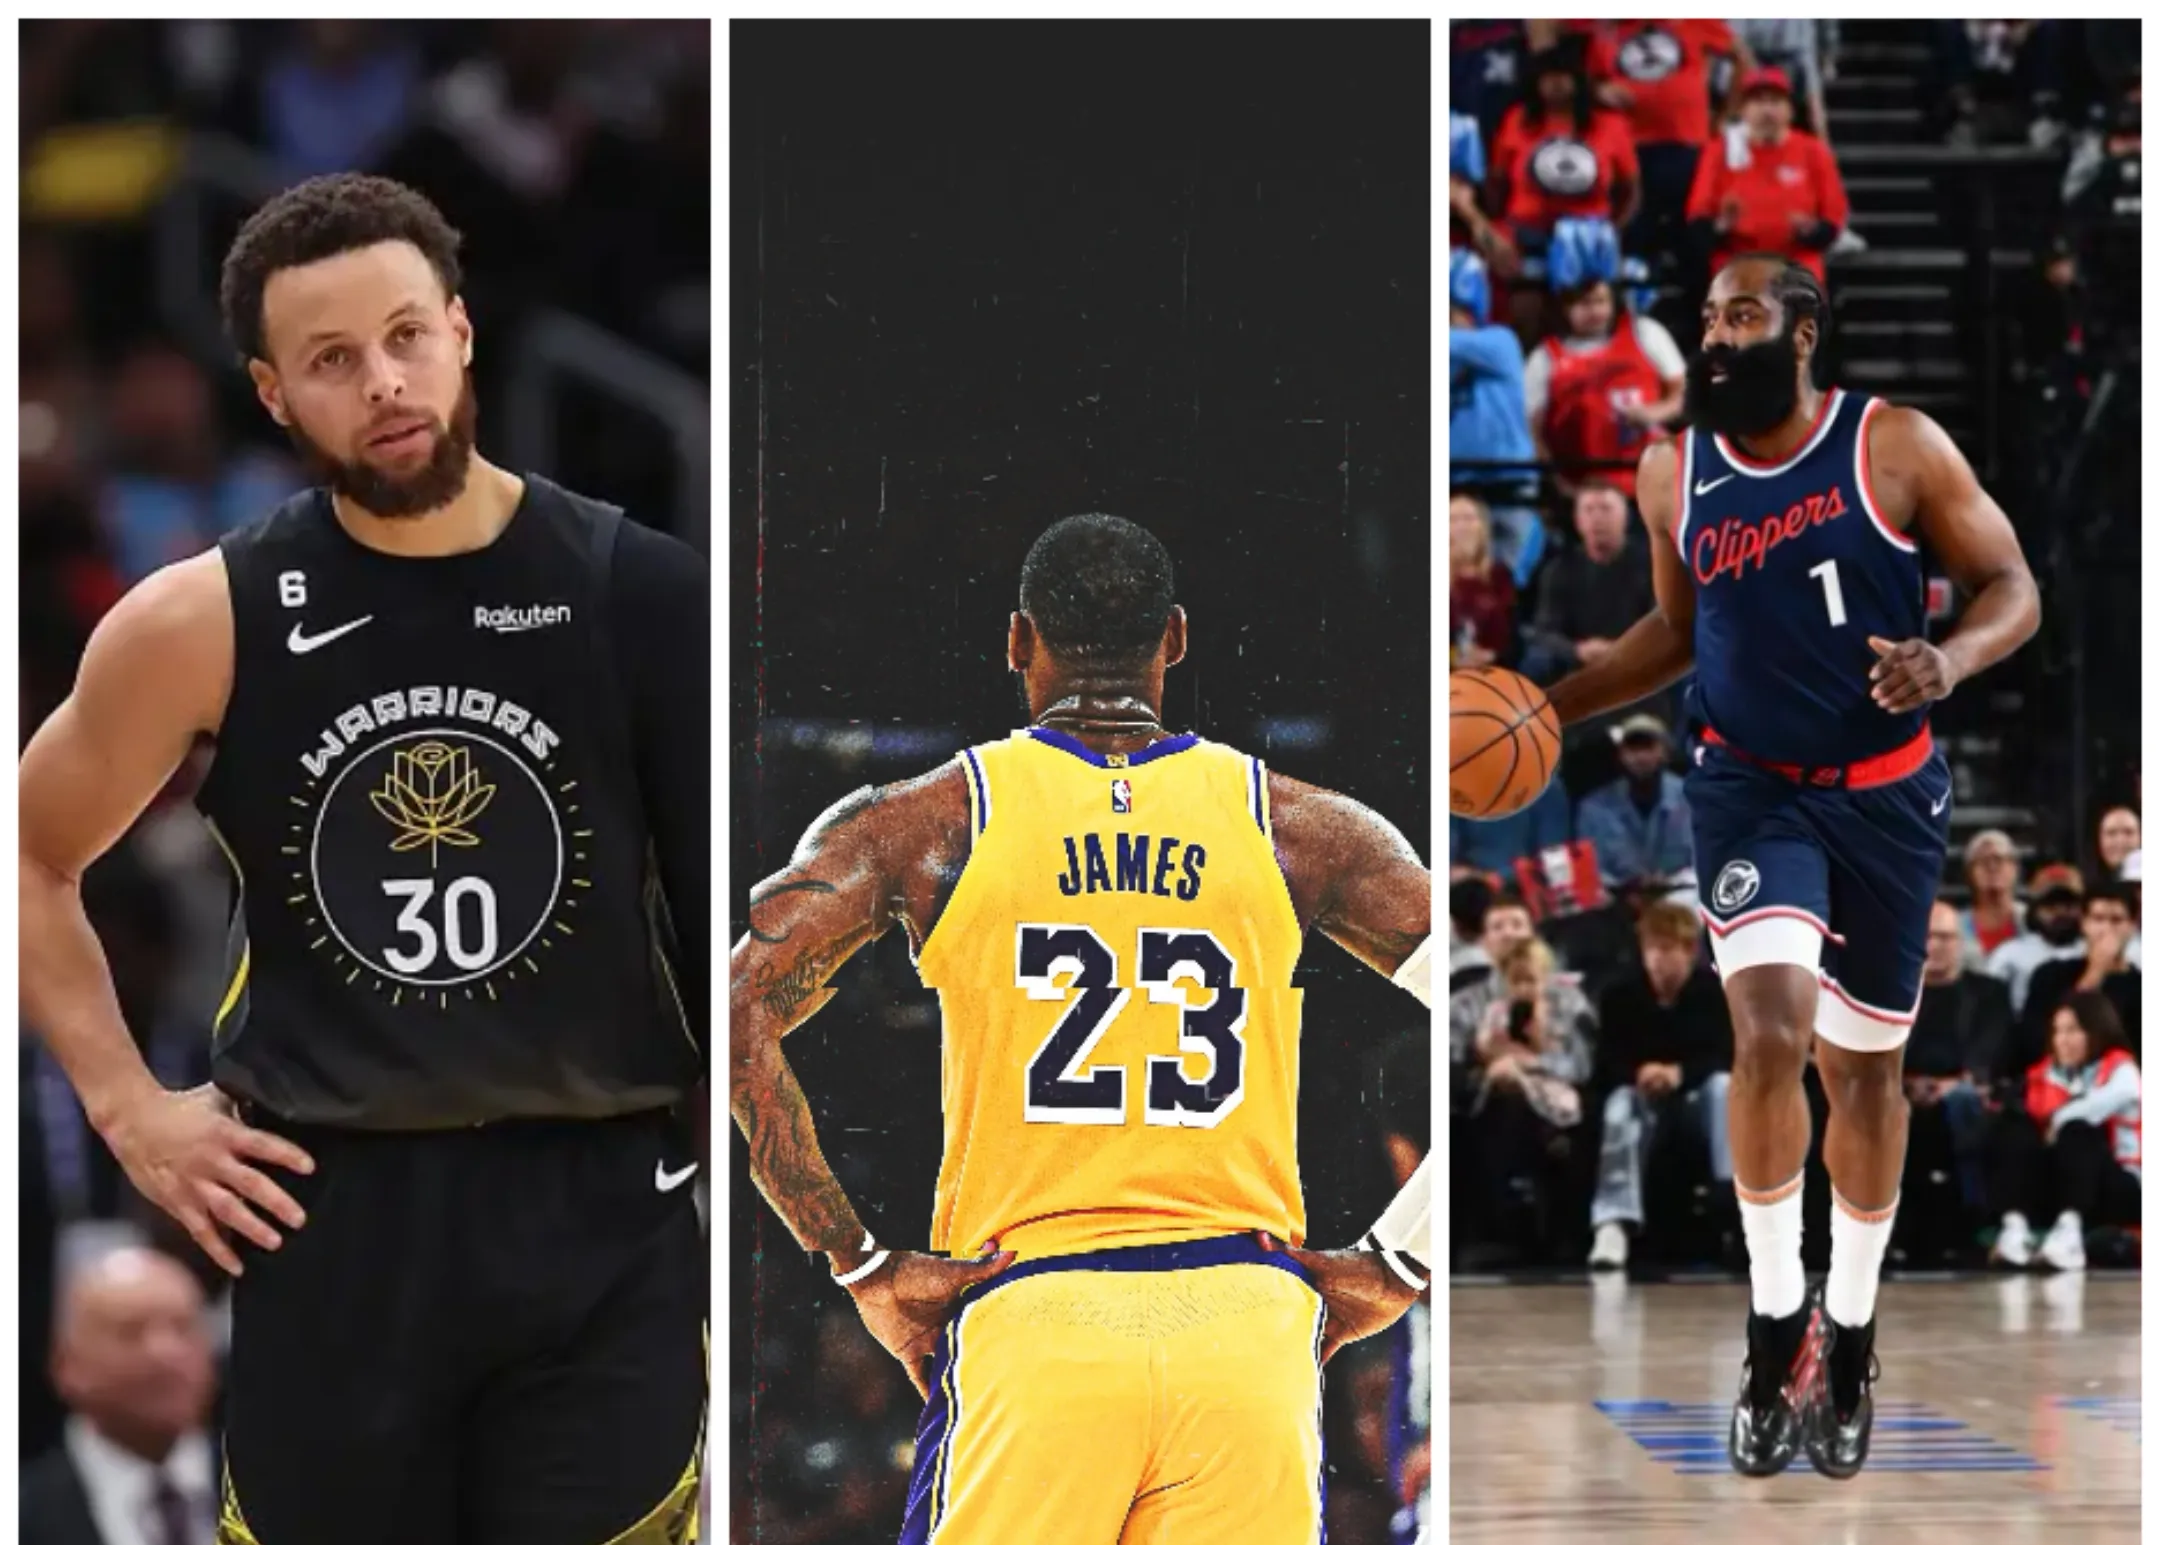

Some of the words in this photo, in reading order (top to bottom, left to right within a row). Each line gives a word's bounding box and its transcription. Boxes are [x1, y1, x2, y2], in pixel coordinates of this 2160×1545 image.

[1692, 485, 1849, 586] Clippers
[278, 570, 307, 608] 6
[474, 603, 572, 632] Rakuten
[1808, 558, 1848, 628] 1
[300, 685, 561, 777] WARRIORS
[1057, 832, 1206, 902] JAMES
[380, 876, 498, 973] 30
[1015, 921, 1249, 1128] 23
